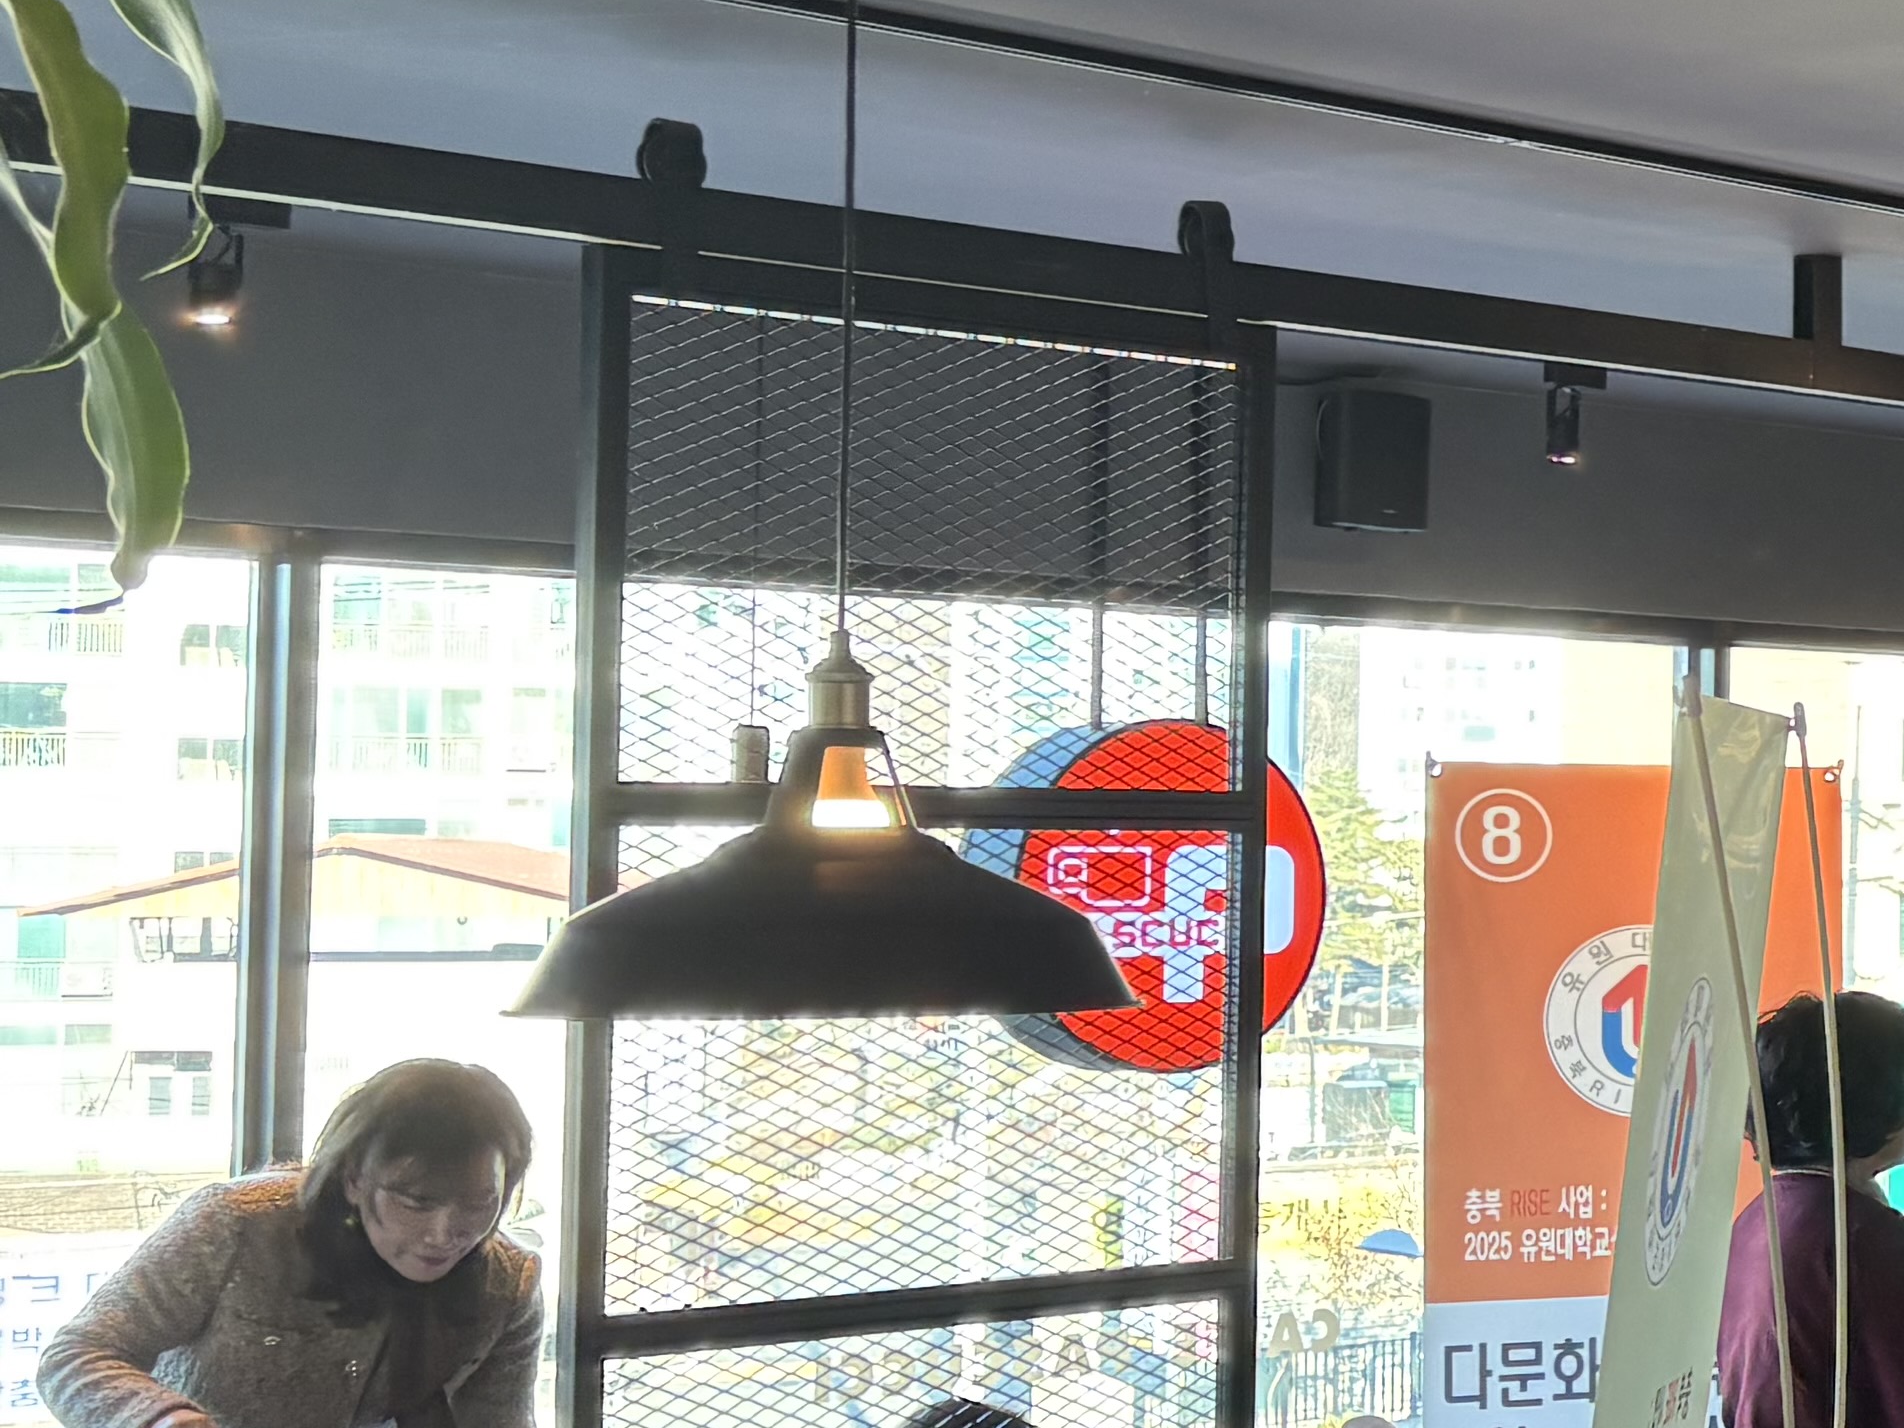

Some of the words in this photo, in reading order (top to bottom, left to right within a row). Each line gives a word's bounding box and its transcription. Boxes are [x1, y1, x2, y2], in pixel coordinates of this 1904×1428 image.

[1464, 1188, 1502, 1224] 충북
[1509, 1188, 1551, 1218] RISE
[1557, 1184, 1594, 1219] 사업
[1464, 1231, 1513, 1261] 2025
[1519, 1225, 1612, 1264] 유원대학교
